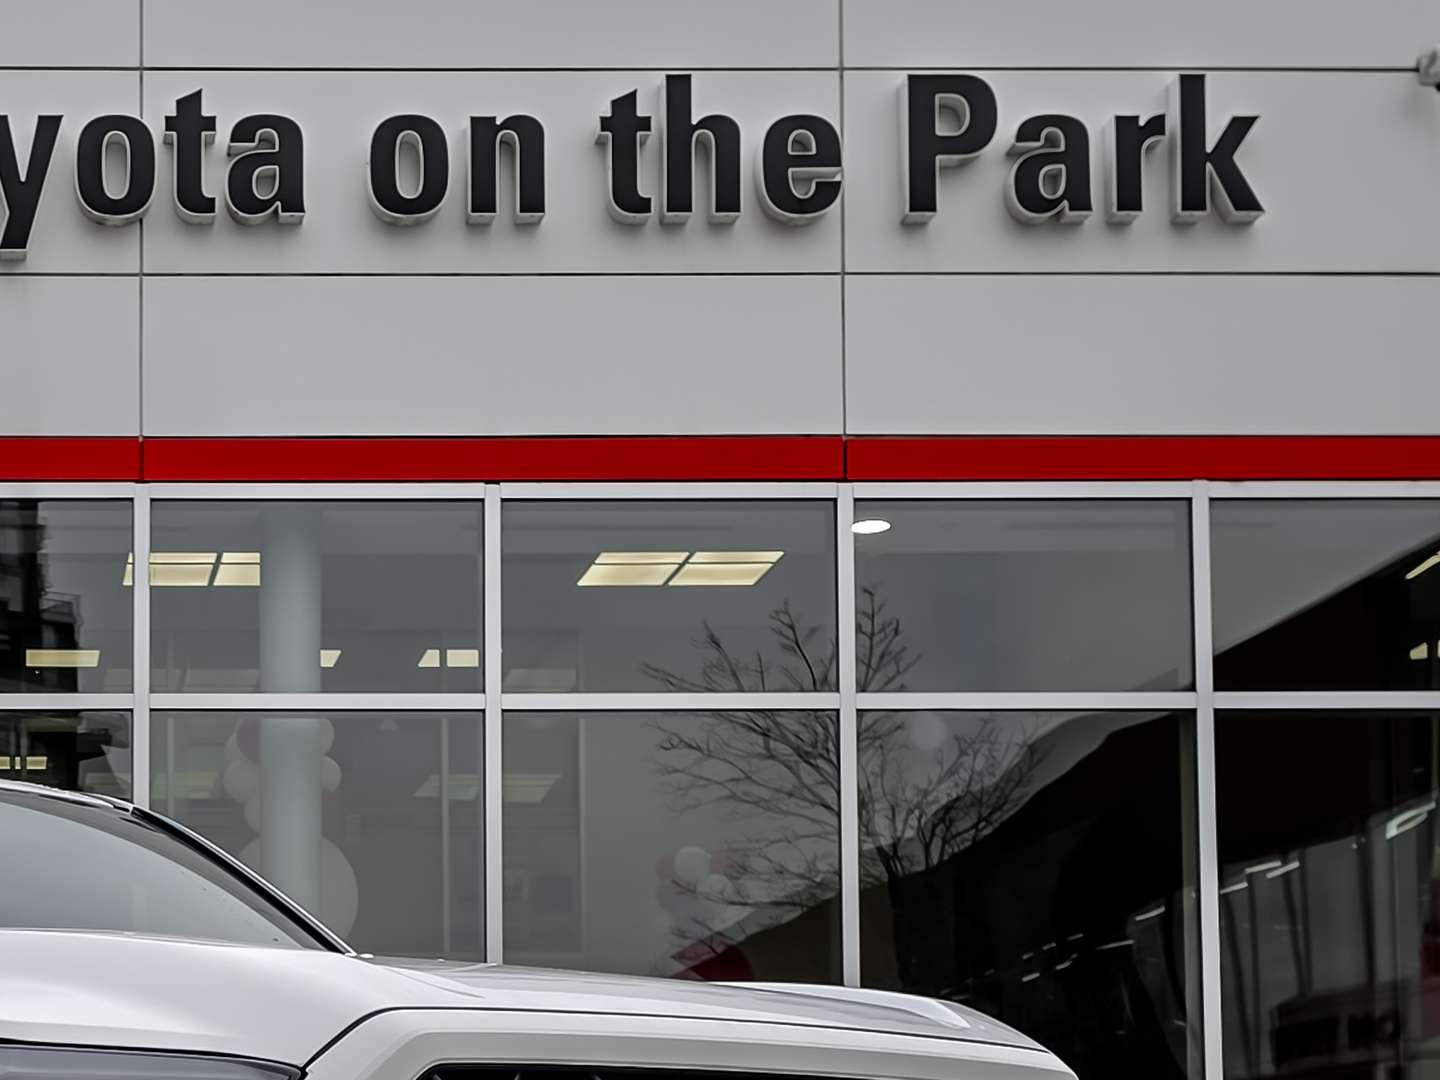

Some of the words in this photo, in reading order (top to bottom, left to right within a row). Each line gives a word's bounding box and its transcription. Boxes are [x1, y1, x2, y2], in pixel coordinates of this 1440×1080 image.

[367, 113, 546, 225] on
[595, 73, 844, 225] the
[901, 73, 1266, 225] Park
